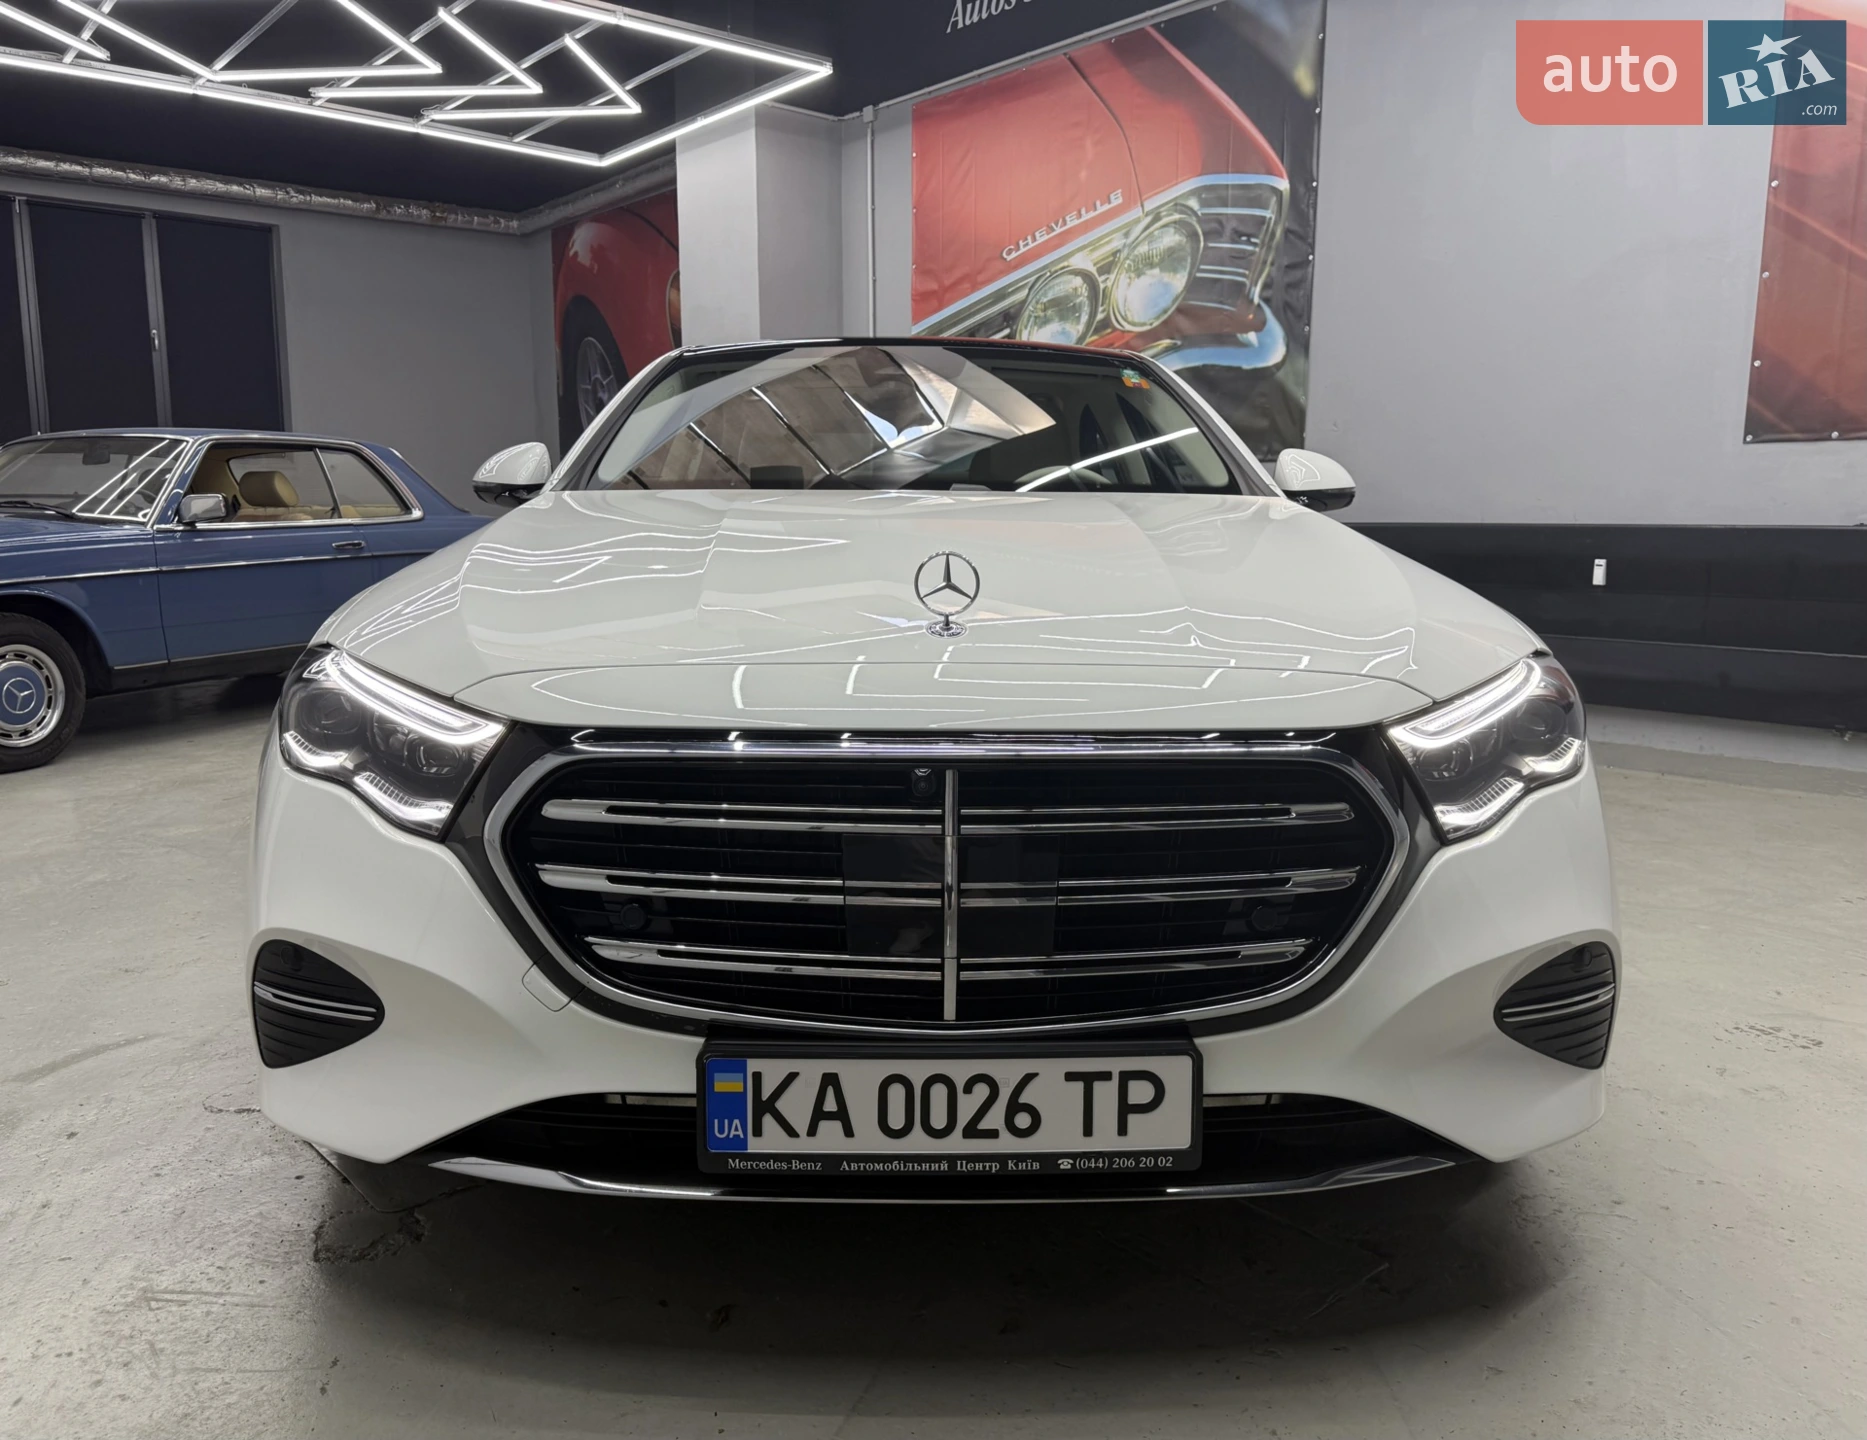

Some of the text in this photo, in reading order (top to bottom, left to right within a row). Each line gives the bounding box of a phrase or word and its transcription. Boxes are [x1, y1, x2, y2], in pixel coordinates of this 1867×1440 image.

[1001, 188, 1123, 261] CHEVELLE
[751, 1069, 1166, 1140] KA 0026 TP
[713, 1118, 744, 1139] UA
[727, 1156, 1173, 1173] Mercedes-Benz Автомобільний Центр Київ (044) 206 20 02
